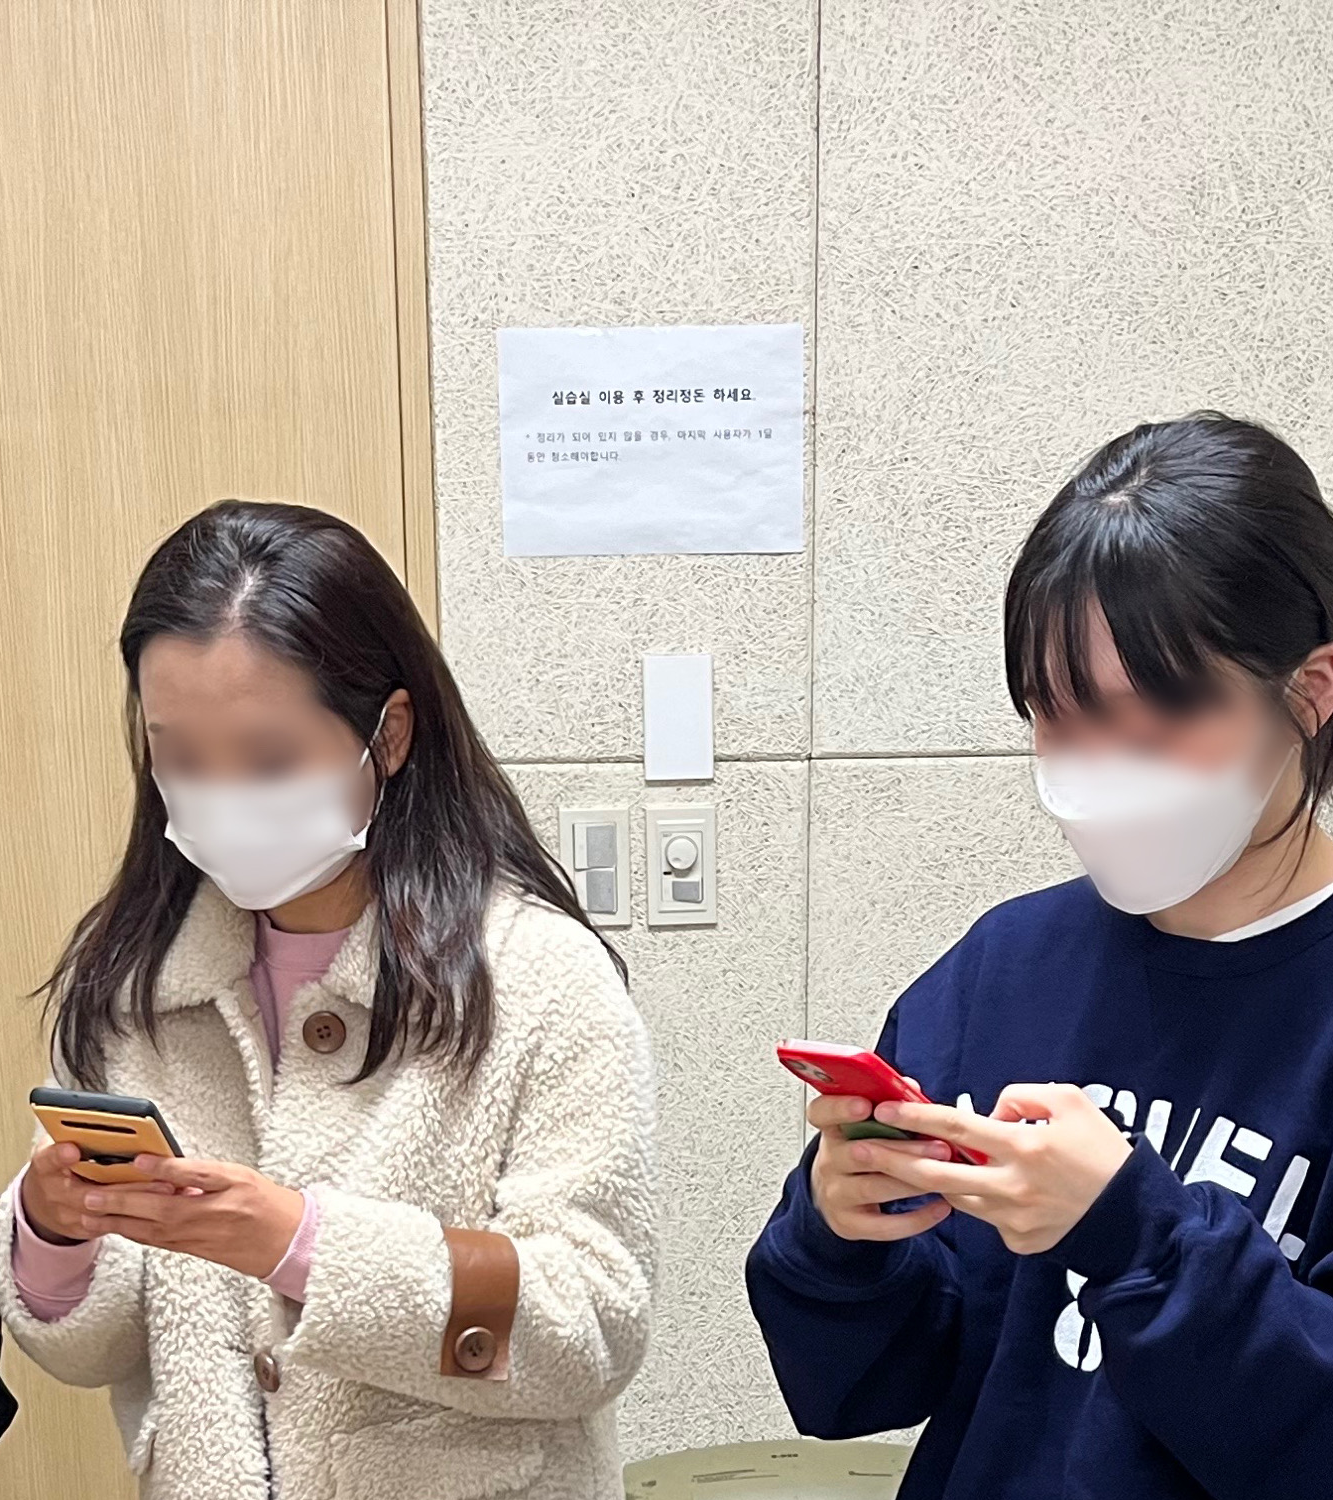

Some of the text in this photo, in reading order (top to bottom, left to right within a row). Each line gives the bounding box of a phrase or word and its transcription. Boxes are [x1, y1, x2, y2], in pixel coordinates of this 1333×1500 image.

[551, 390, 591, 406] 실습실
[598, 390, 625, 405] 이용
[632, 390, 646, 404] 후
[652, 388, 706, 404] 정리정돈
[536, 432, 566, 444] 정리가
[571, 432, 591, 443] 되어
[676, 429, 707, 441] 마지막
[713, 429, 752, 440] 사용자가
